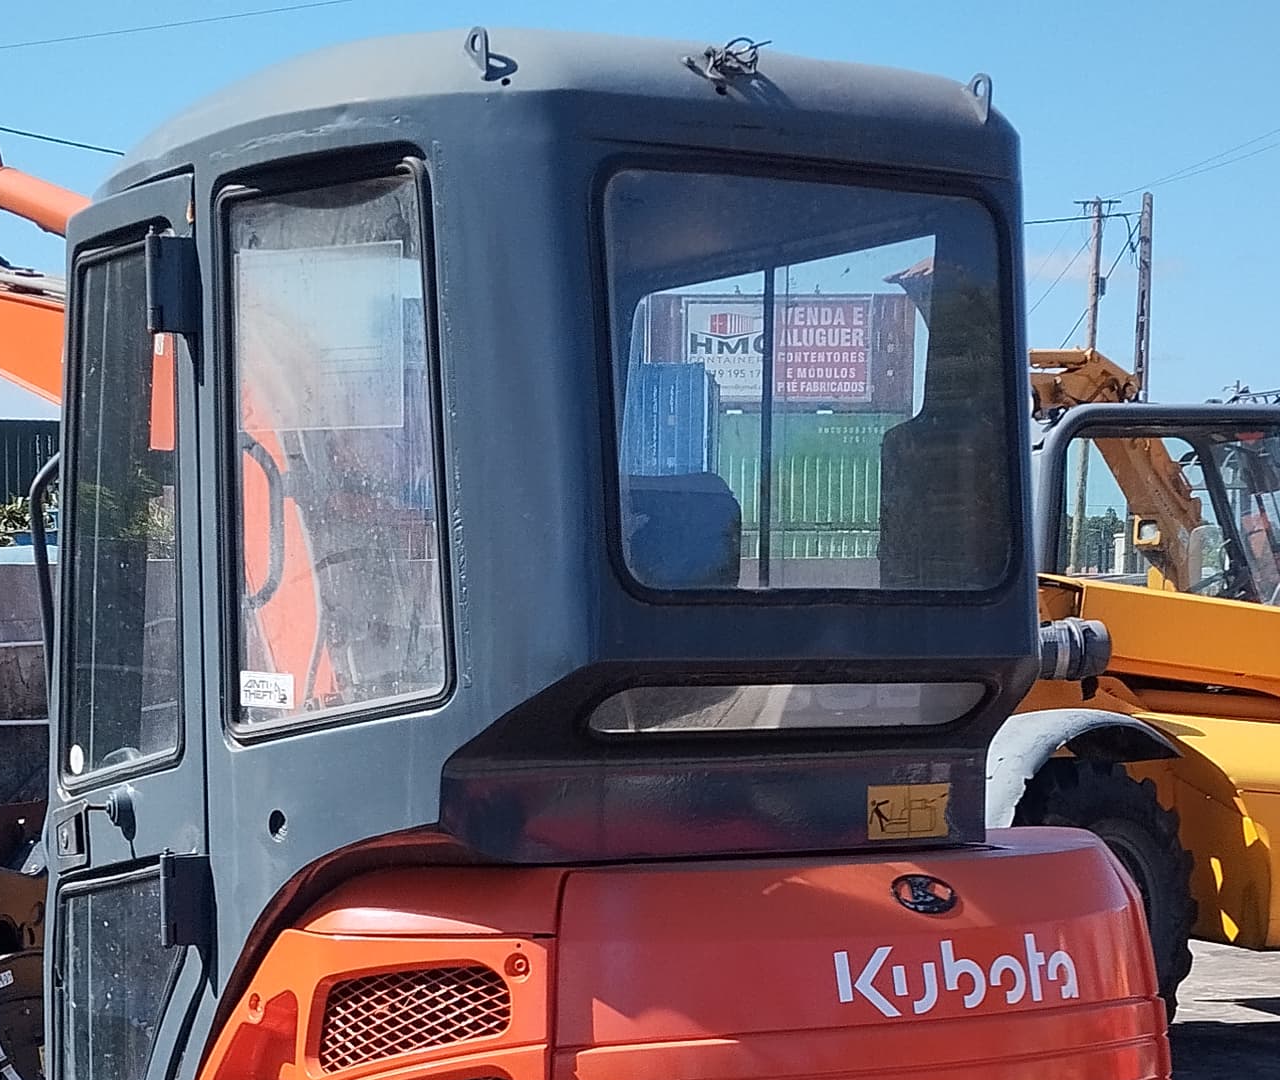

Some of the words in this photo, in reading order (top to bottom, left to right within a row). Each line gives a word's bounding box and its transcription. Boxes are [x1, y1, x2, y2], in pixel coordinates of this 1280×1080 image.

[780, 306, 845, 326] VENDA
[852, 306, 864, 326] E
[779, 328, 865, 347] ALUGUER
[777, 352, 865, 362] CONTENTORES
[786, 367, 793, 379] E
[800, 381, 866, 393] FABRICADOS
[243, 689, 273, 702] THEFT
[833, 932, 1081, 1018] Kubota
